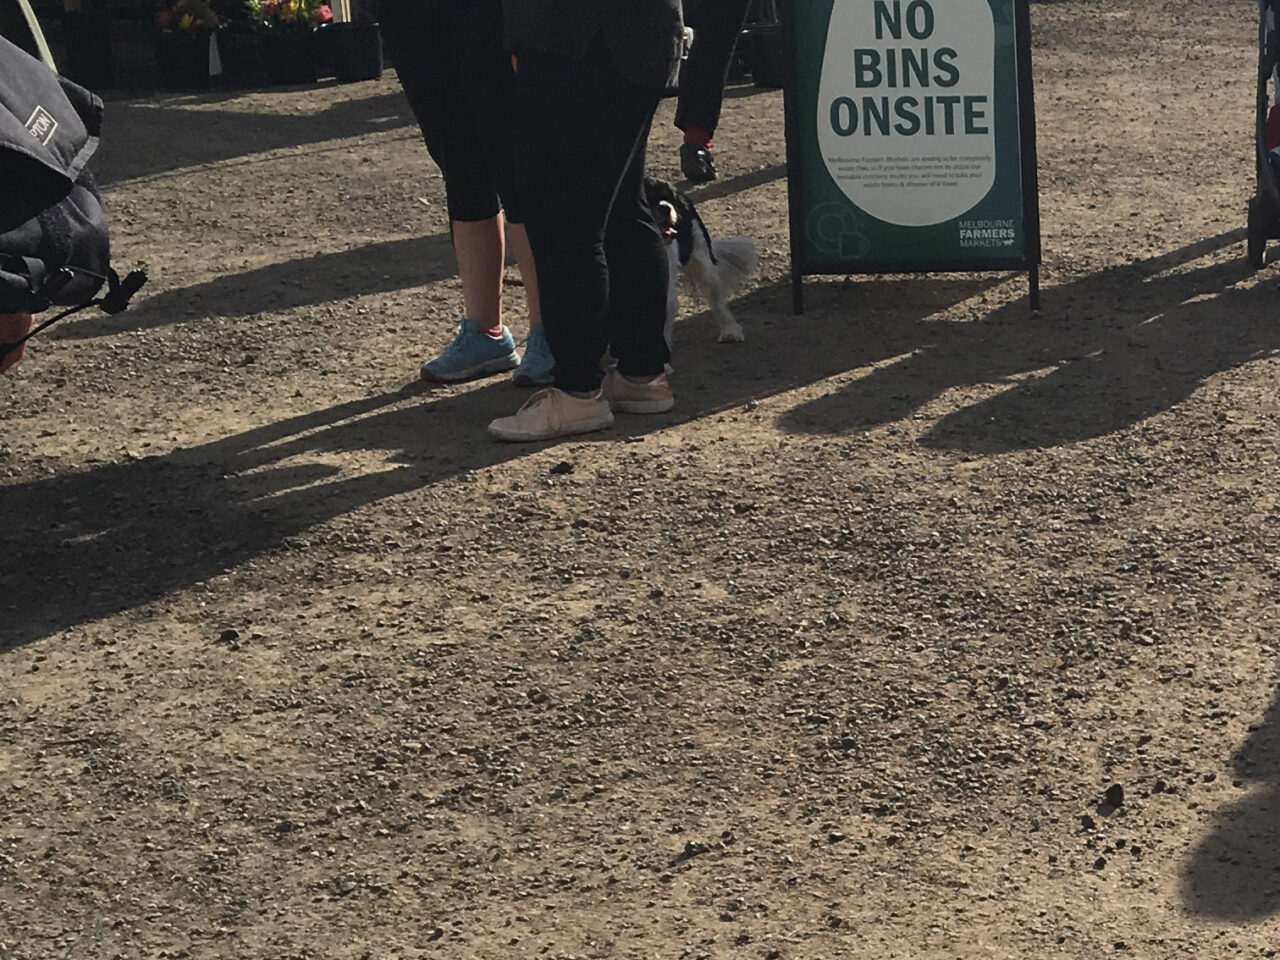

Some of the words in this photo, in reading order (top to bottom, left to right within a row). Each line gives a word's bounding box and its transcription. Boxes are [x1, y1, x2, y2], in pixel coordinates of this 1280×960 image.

[874, 0, 934, 40] NO
[854, 47, 960, 89] BINS
[830, 96, 989, 137] ONSITE
[960, 220, 1014, 228] MELBOURNE
[960, 229, 1015, 238] FARMERS
[960, 239, 1001, 247] MARKETS
